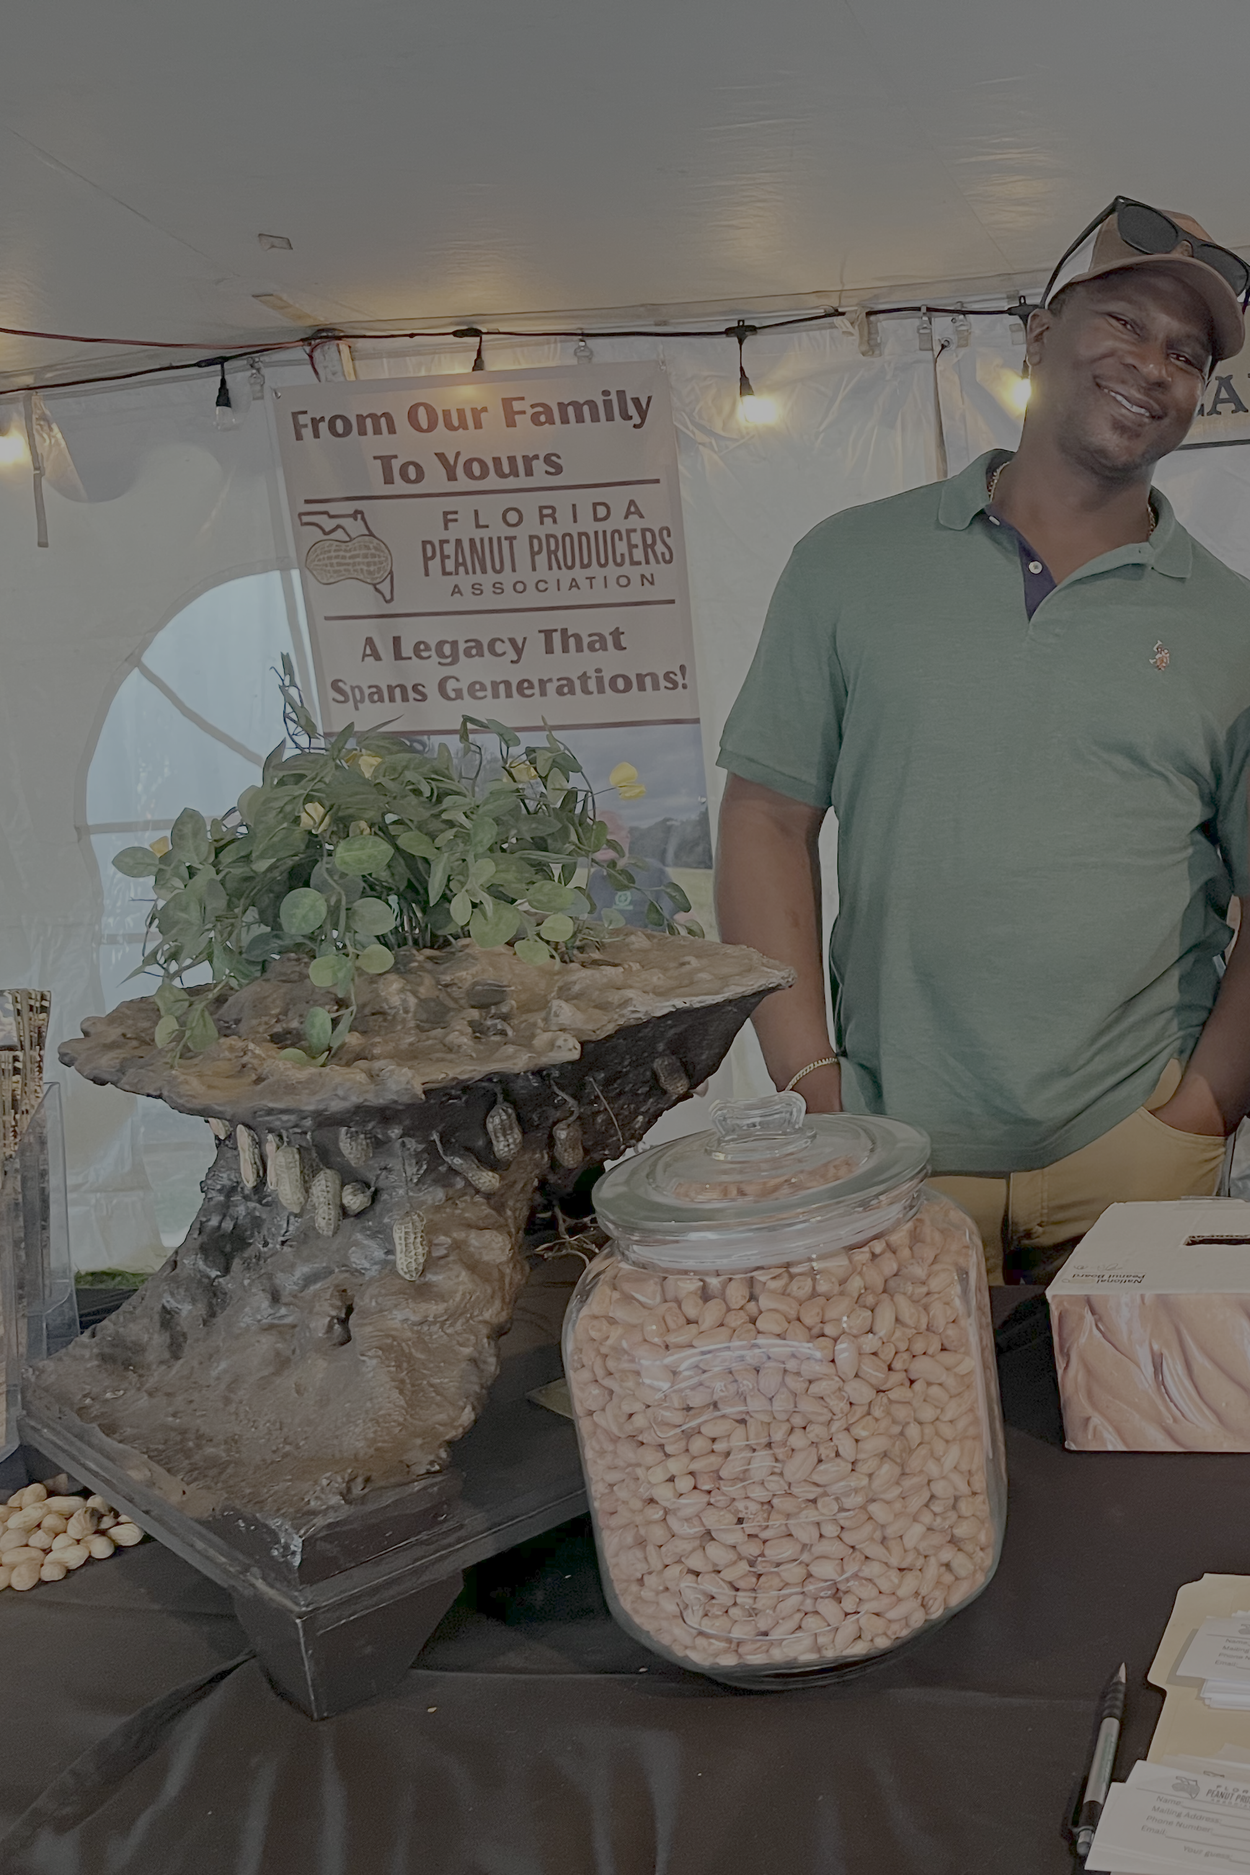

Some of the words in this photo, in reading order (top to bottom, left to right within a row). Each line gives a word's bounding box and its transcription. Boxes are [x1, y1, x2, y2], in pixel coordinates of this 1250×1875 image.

[291, 410, 397, 441] From
[407, 402, 488, 433] Our
[501, 389, 653, 430] Family
[373, 454, 425, 485] To
[434, 451, 564, 482] Yours
[442, 498, 645, 531] FLORIDA
[421, 535, 517, 577] PEANUT
[528, 527, 674, 572] PRODUCERS
[449, 573, 656, 598] ASSOCIATION
[361, 638, 382, 663] A
[391, 634, 527, 666] Legacy
[538, 626, 627, 655] That
[330, 678, 428, 710] Spans
[438, 665, 688, 702] Generations!
[1218, 1652, 1243, 1660] Phone
[1222, 1645, 1250, 1653] Mailing
[1156, 1796, 1183, 1807] Name:
[1206, 1789, 1234, 1801] PEANUT
[1146, 1816, 1174, 1826] Phone
[1176, 1822, 1214, 1834] Number:
[1152, 1805, 1183, 1818] Mailing
[1183, 1810, 1224, 1826] Address:
[1140, 1825, 1168, 1836] Email:
[1183, 1846, 1202, 1854] Your
